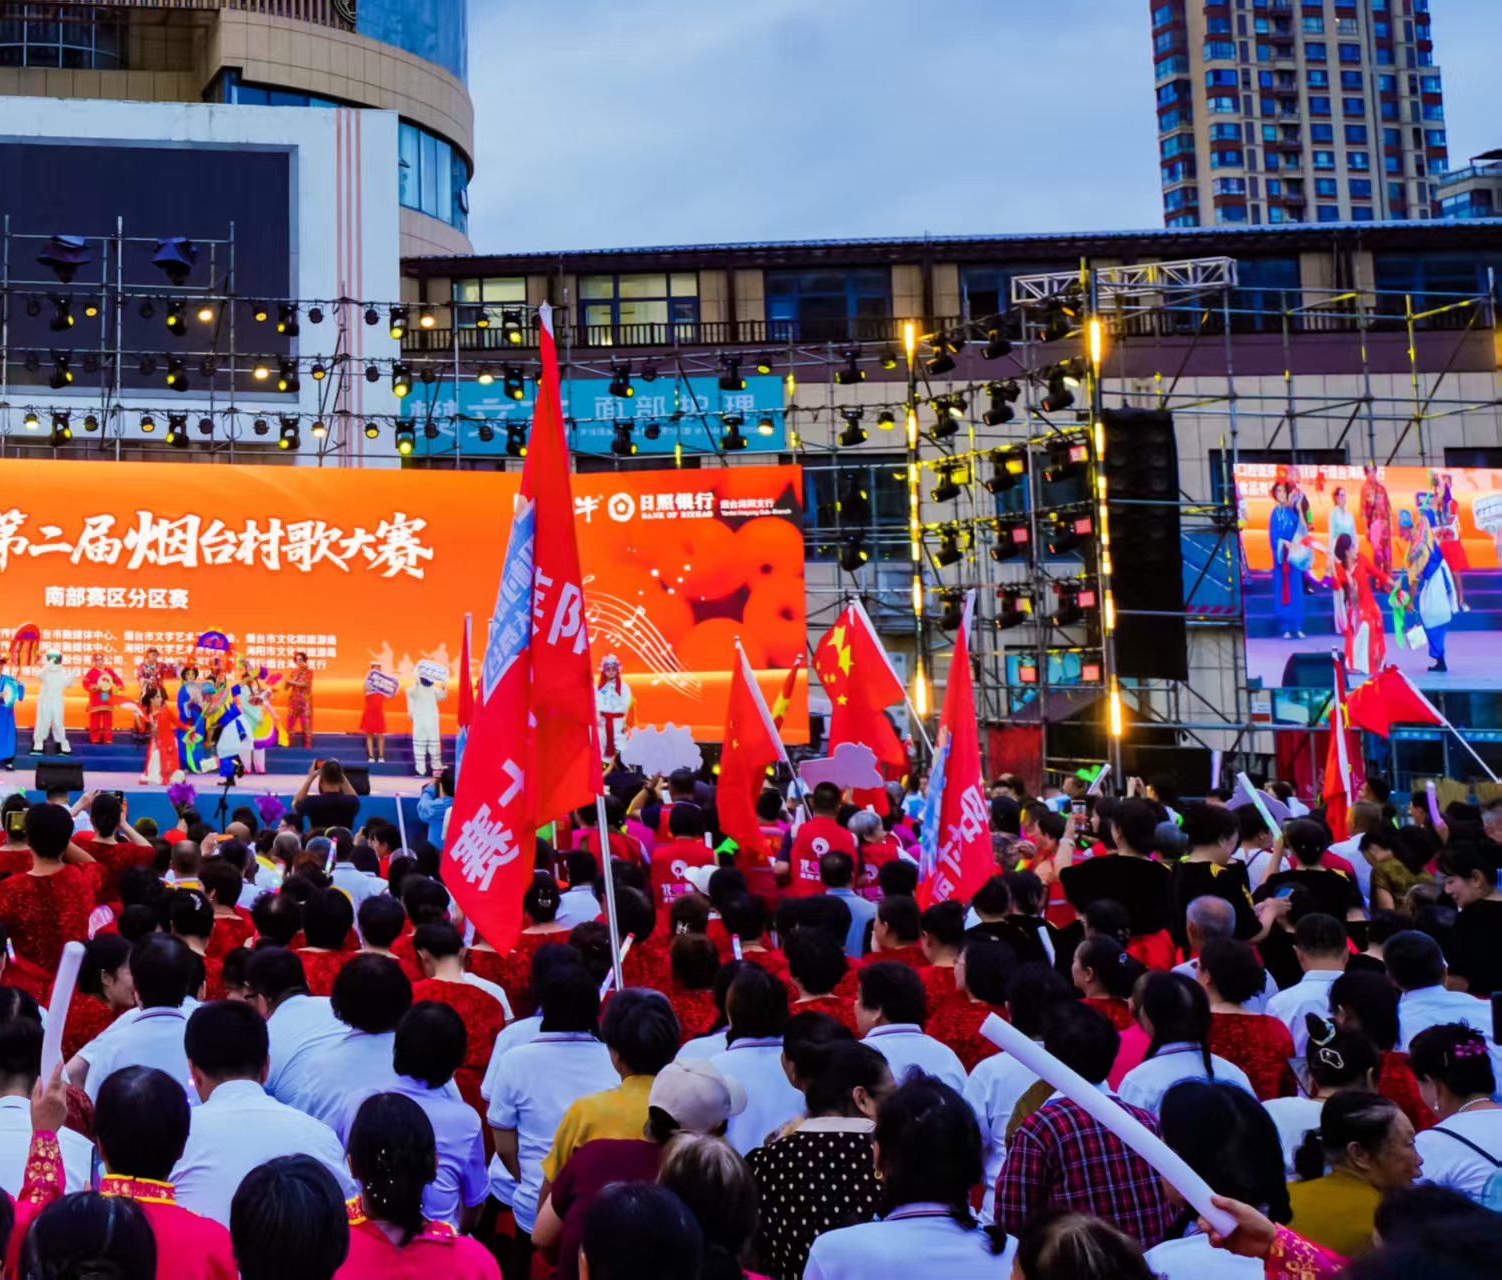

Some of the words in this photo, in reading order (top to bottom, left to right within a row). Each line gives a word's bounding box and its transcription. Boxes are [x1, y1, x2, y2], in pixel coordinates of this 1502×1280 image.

[640, 492, 715, 511] 日照银行
[44, 585, 189, 609] 南部赛区分区赛
